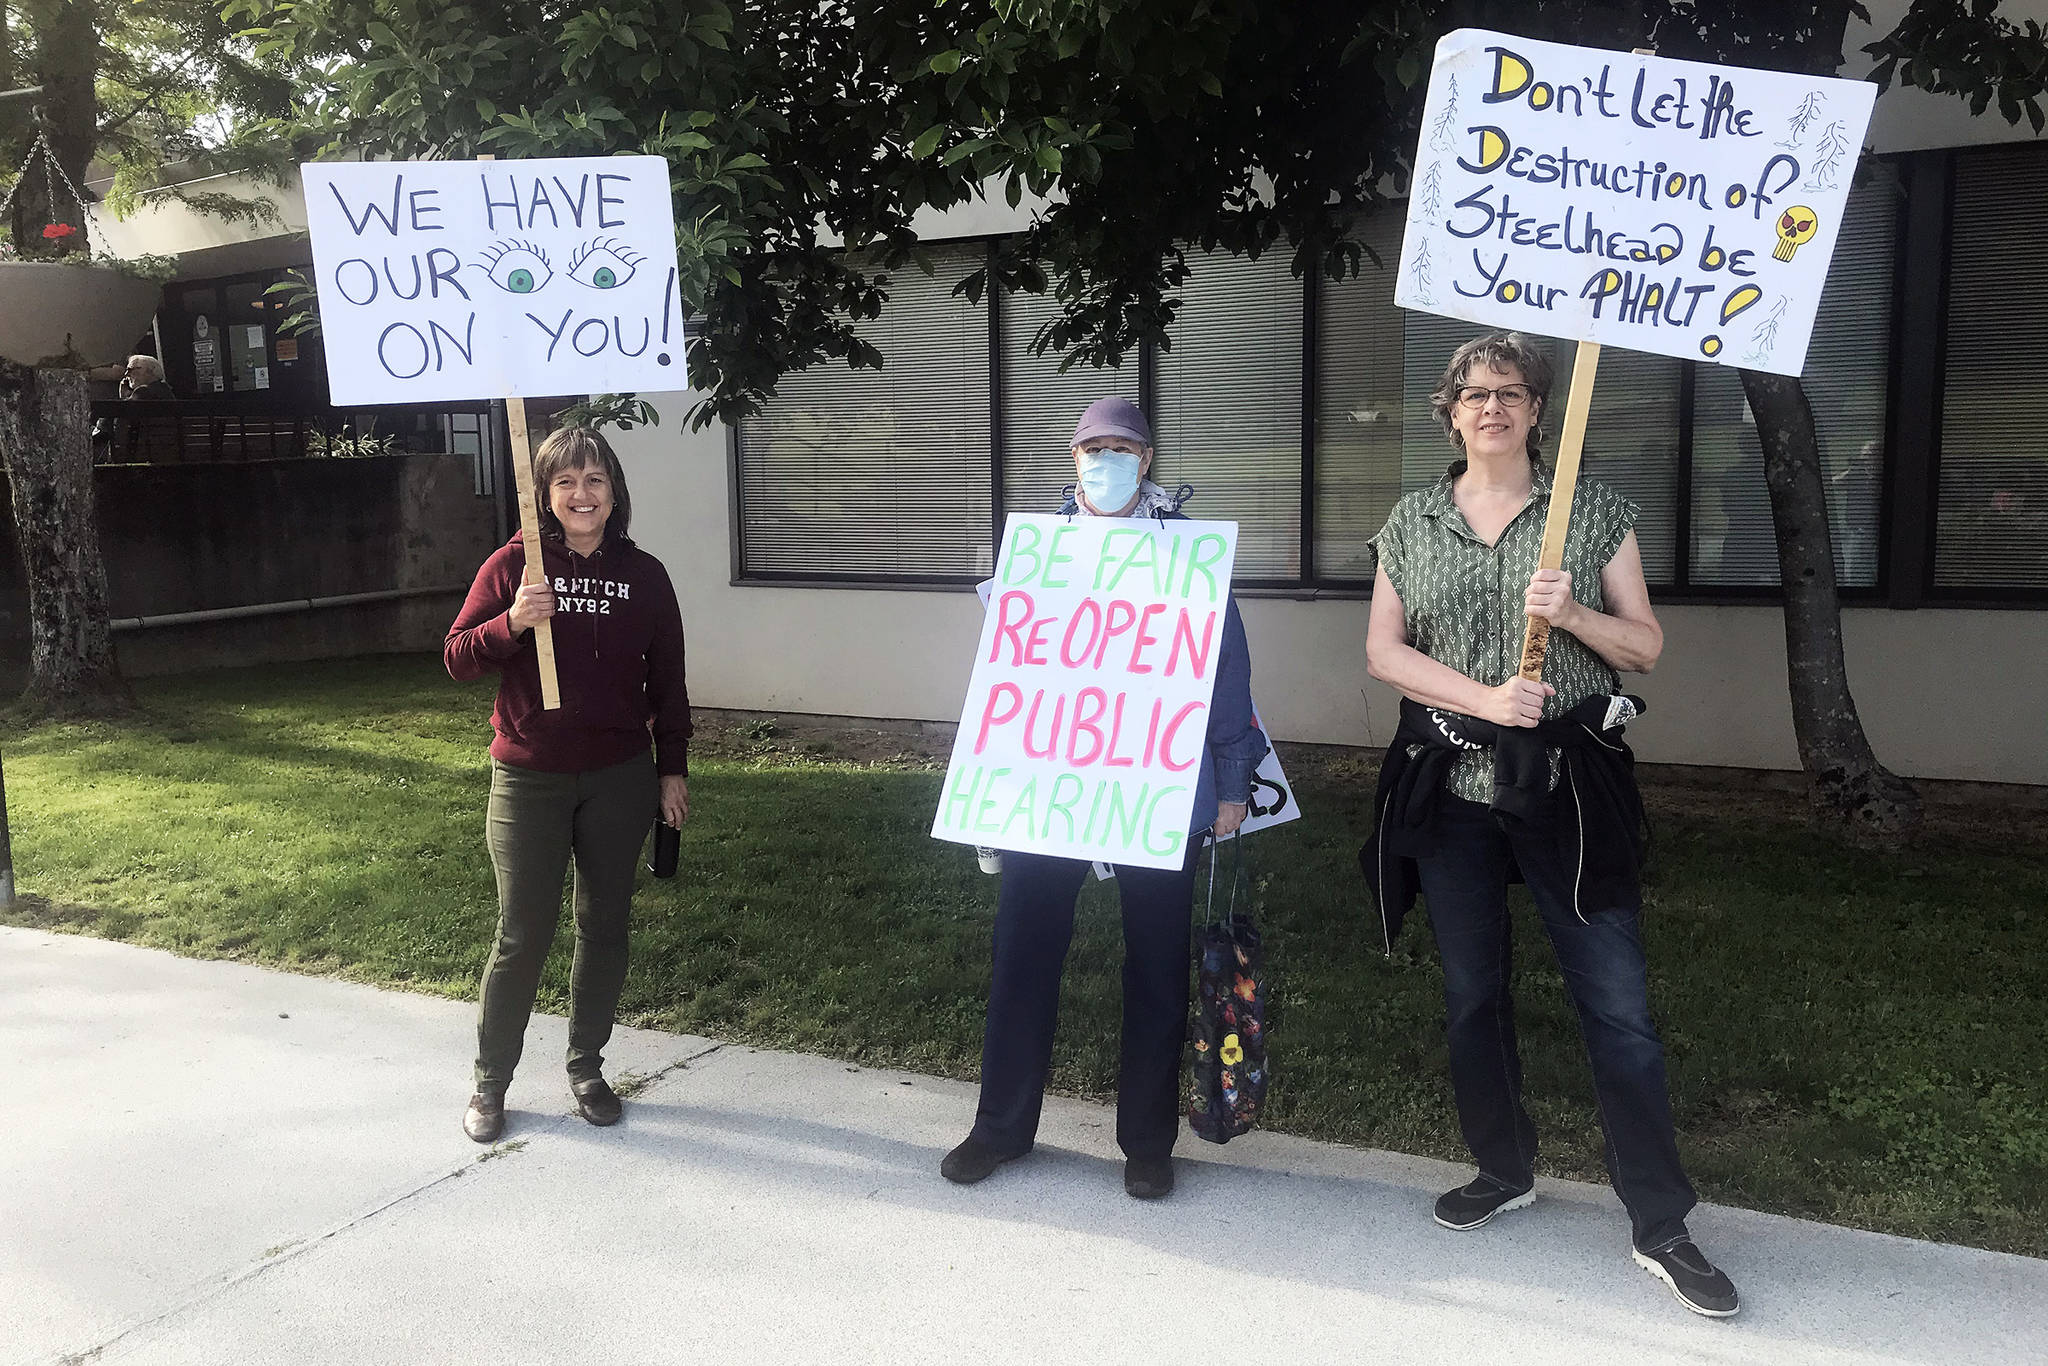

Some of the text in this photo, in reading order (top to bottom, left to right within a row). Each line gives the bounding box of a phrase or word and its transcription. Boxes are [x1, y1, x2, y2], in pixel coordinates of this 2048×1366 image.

[1482, 46, 1619, 118] Don't
[1630, 67, 1694, 130] Let
[329, 173, 631, 236] WE HAVE
[1457, 126, 1800, 219] Destruction of
[1446, 185, 1757, 277] Steelhead be
[335, 248, 471, 306] OUR
[378, 267, 675, 379] ON YOU!
[557, 596, 610, 615] NY92
[1002, 523, 1227, 602] BE FAIR
[973, 681, 1206, 772] PUBLIC
[942, 765, 1187, 856] HEARING
